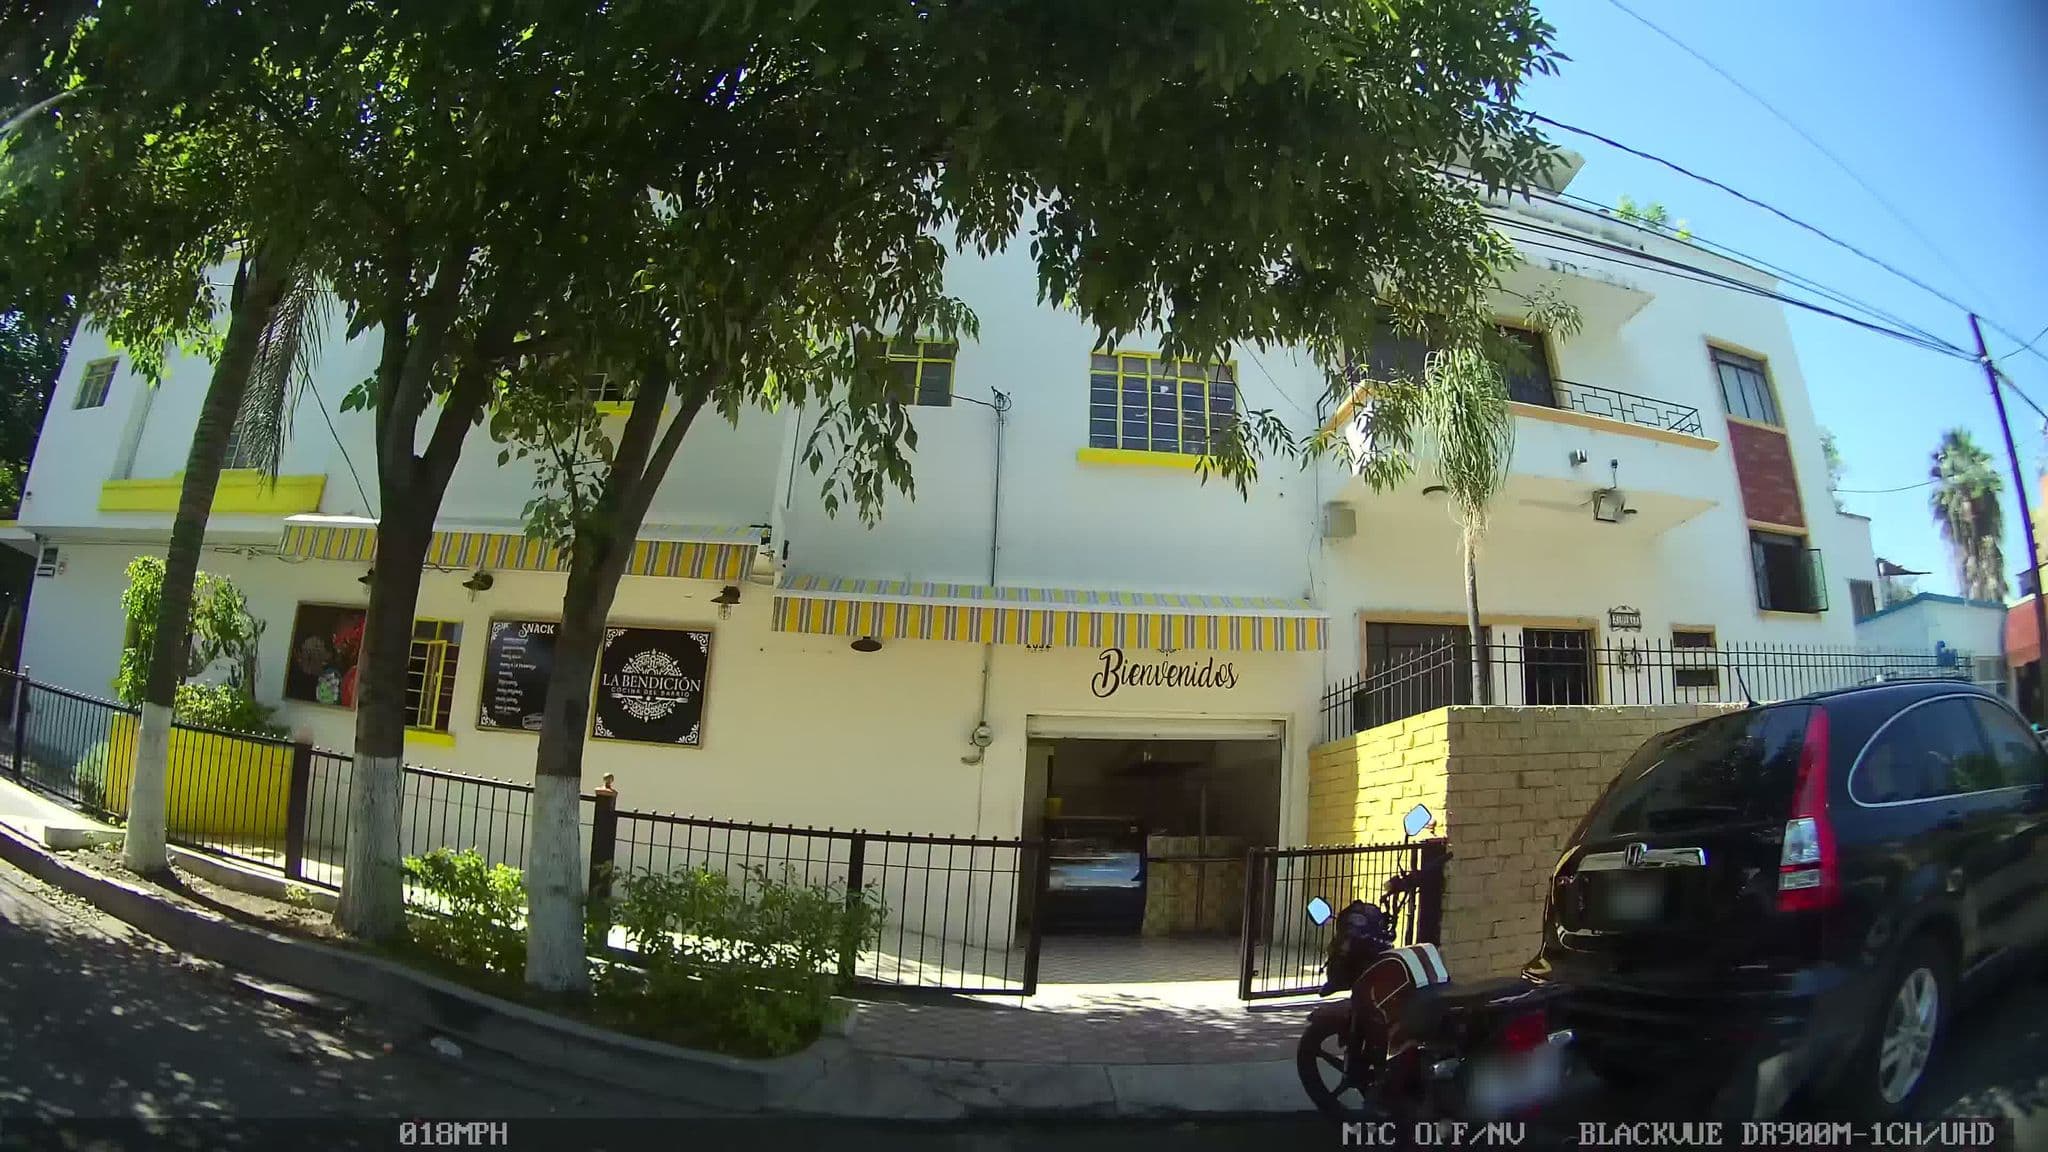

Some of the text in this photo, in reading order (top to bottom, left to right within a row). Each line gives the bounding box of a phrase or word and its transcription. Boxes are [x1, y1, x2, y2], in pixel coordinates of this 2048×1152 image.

[603, 673, 700, 692] LA BENDICIÓN
[1091, 648, 1239, 698] Bienvenidos
[610, 686, 690, 698] COCINA DEL BARRIO
